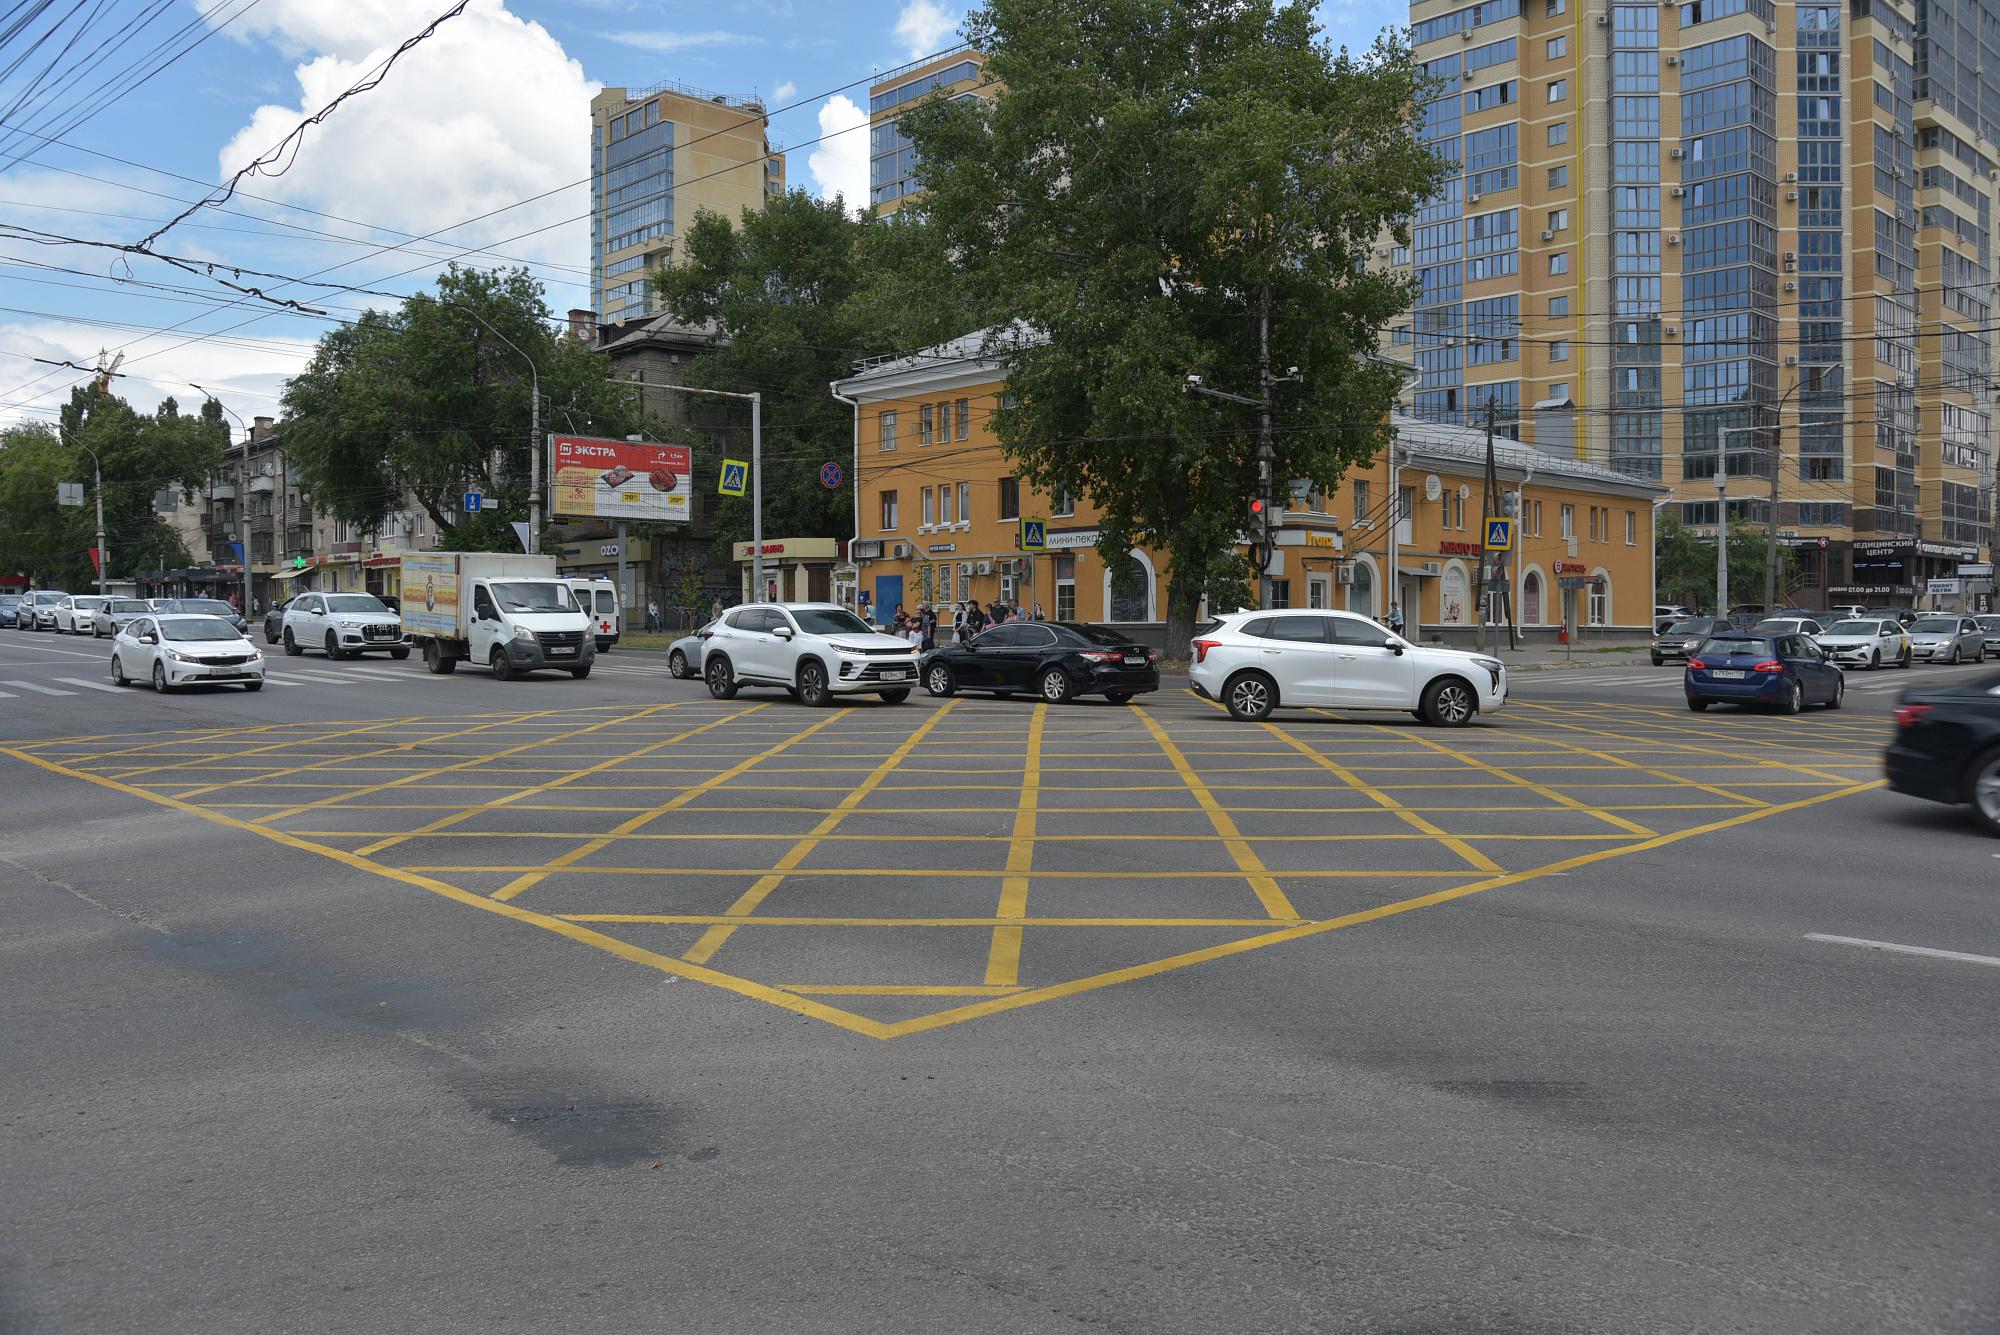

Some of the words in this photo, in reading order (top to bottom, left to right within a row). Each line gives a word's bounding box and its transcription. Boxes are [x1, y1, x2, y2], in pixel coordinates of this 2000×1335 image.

[575, 445, 616, 457] ЭКСТРА
[600, 545, 618, 556] OZO
[1980, 594, 1988, 612] КЛЮ
